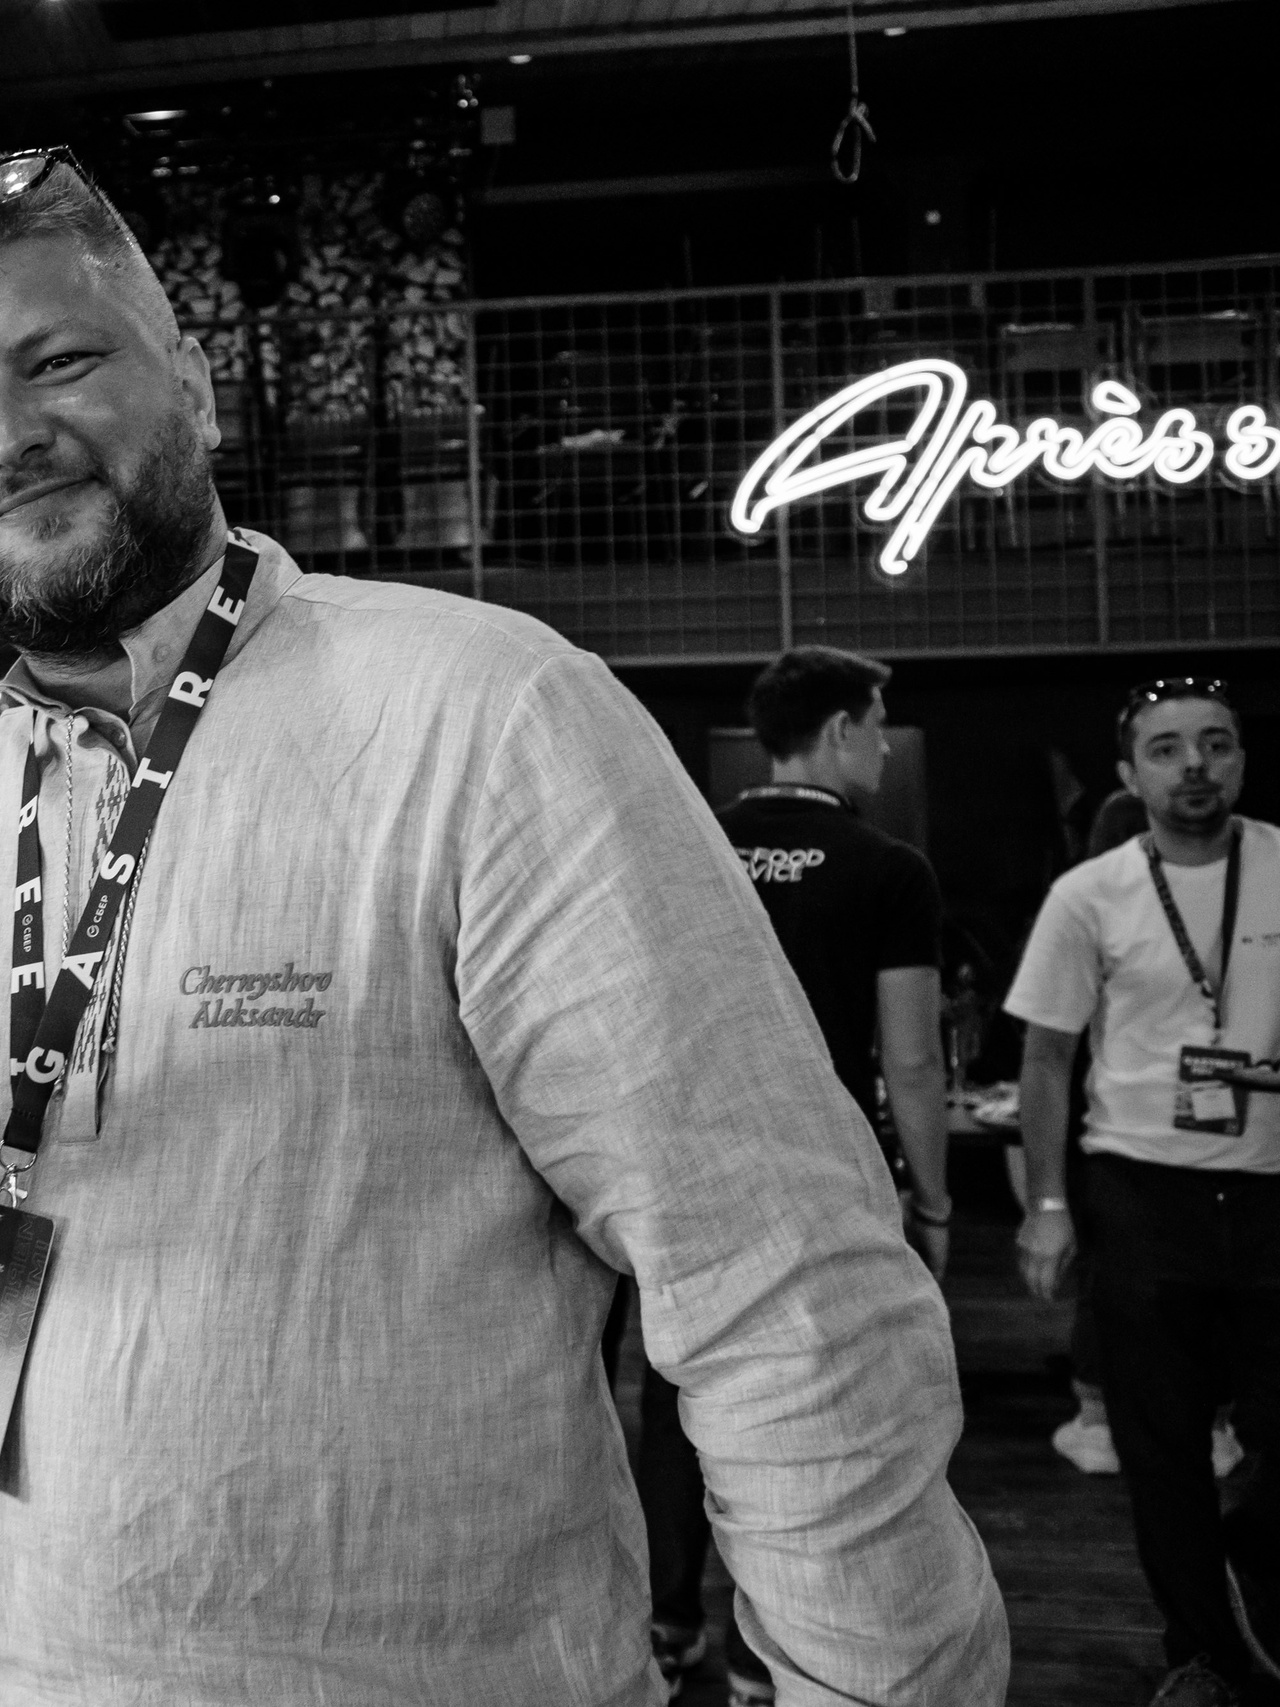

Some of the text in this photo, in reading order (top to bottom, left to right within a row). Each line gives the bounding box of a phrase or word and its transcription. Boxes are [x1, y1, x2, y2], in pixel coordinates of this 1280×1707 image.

[731, 358, 1214, 575] Après
[745, 859, 803, 883] VICE
[94, 895, 108, 923] СБЕР
[179, 962, 333, 1000] Chernyshov
[188, 998, 326, 1029] Aleksandr
